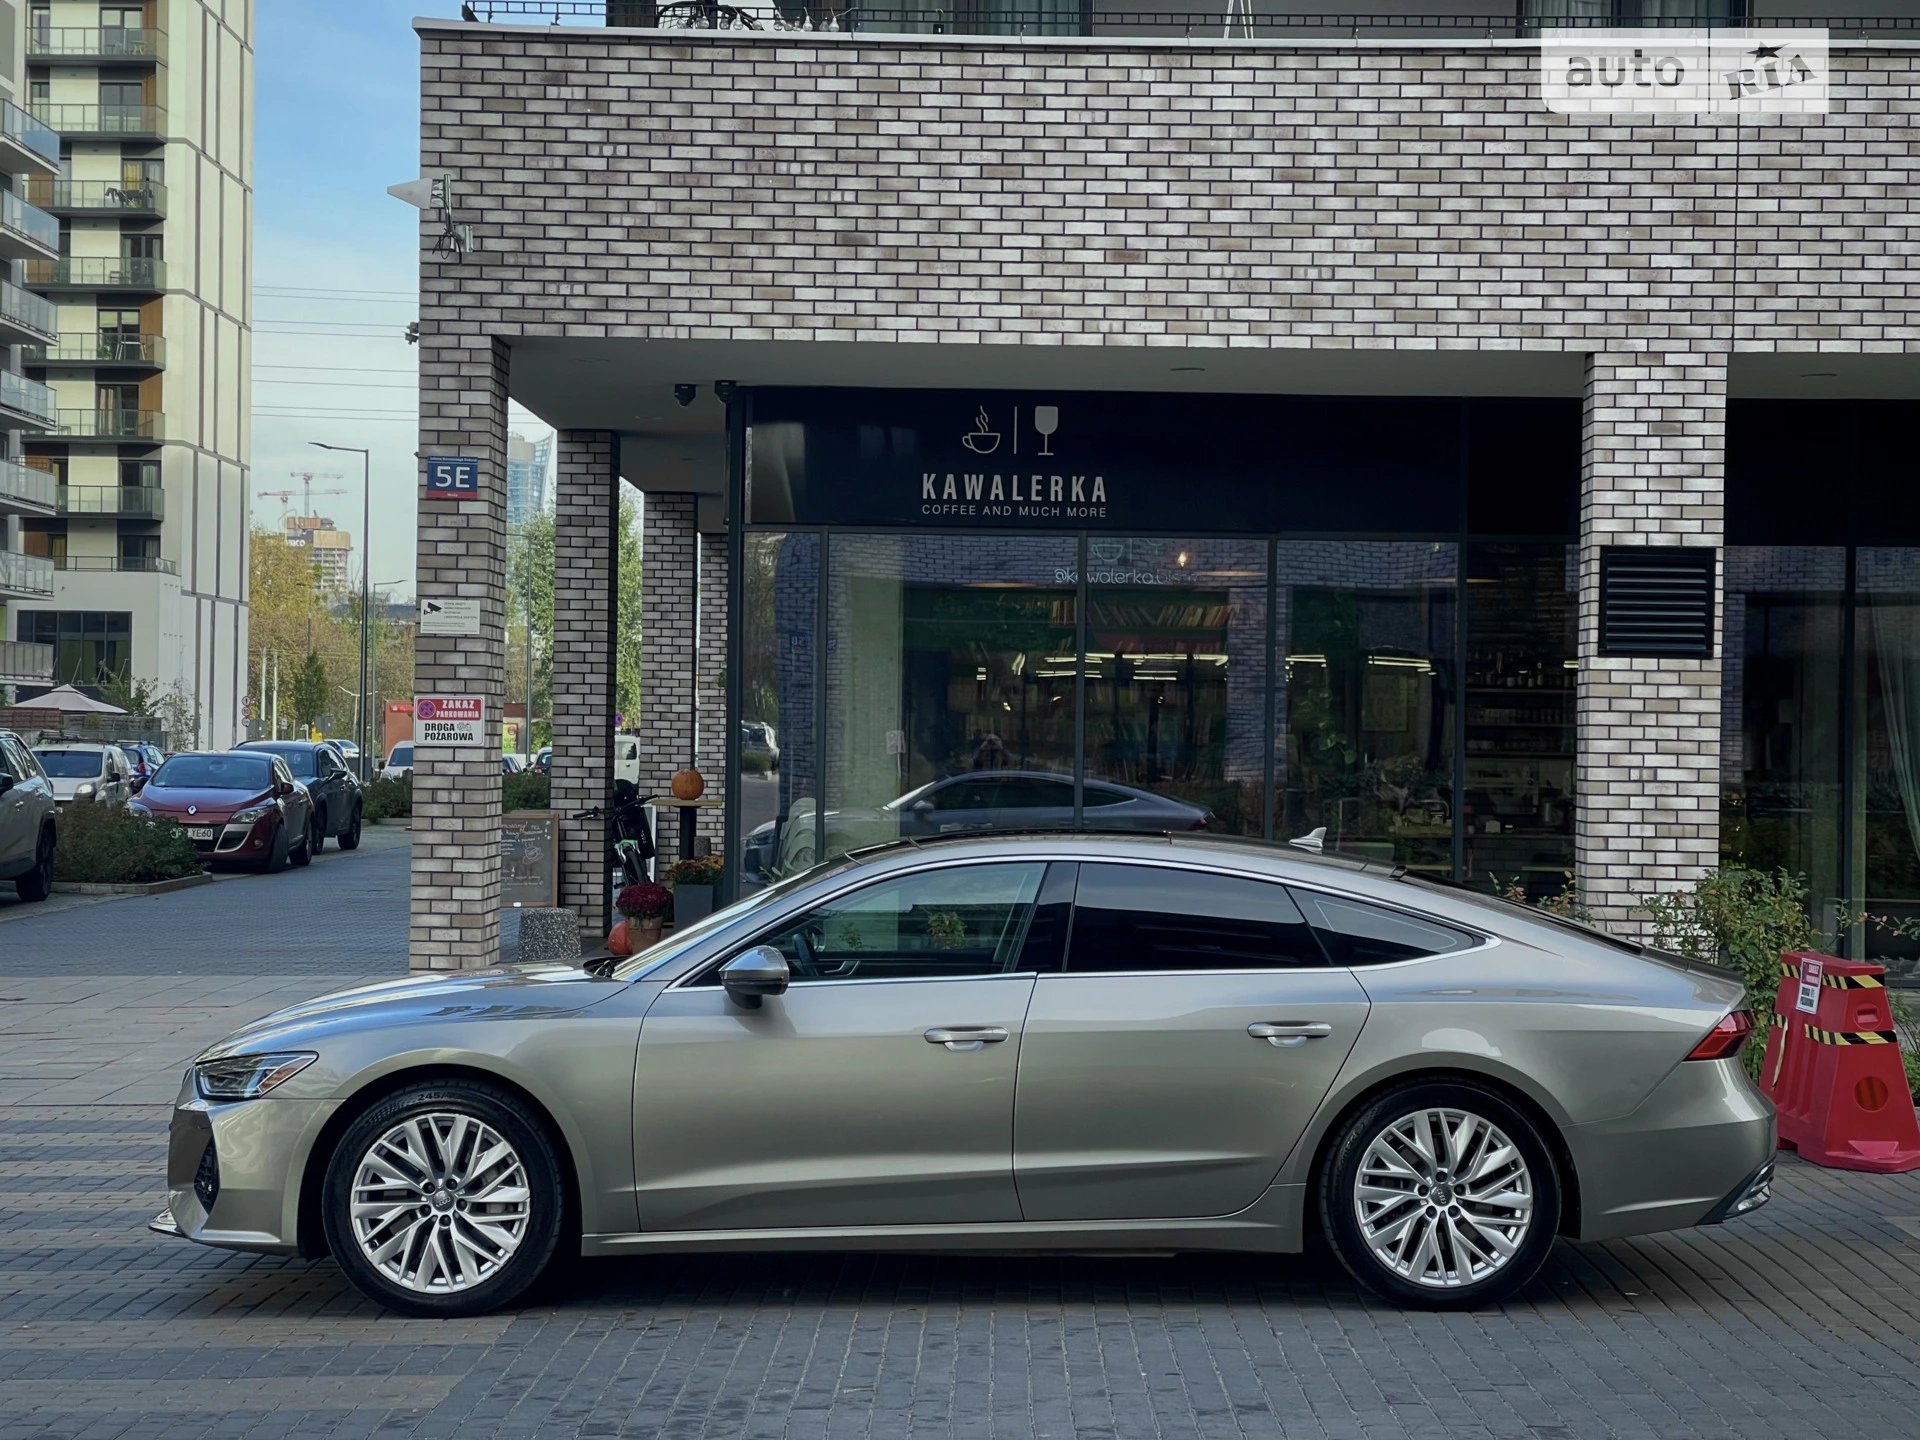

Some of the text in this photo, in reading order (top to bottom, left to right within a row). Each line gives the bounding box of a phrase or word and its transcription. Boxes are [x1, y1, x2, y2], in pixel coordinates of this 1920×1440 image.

[435, 466, 470, 488] 5E
[922, 473, 1106, 502] KAWALERKA
[922, 504, 1107, 518] COFFEE AND MUCH MORE
[442, 700, 475, 709] ZAKAZ
[424, 723, 456, 732] DROGA
[424, 731, 474, 741] POŻAROWA
[187, 828, 212, 839] YE60
